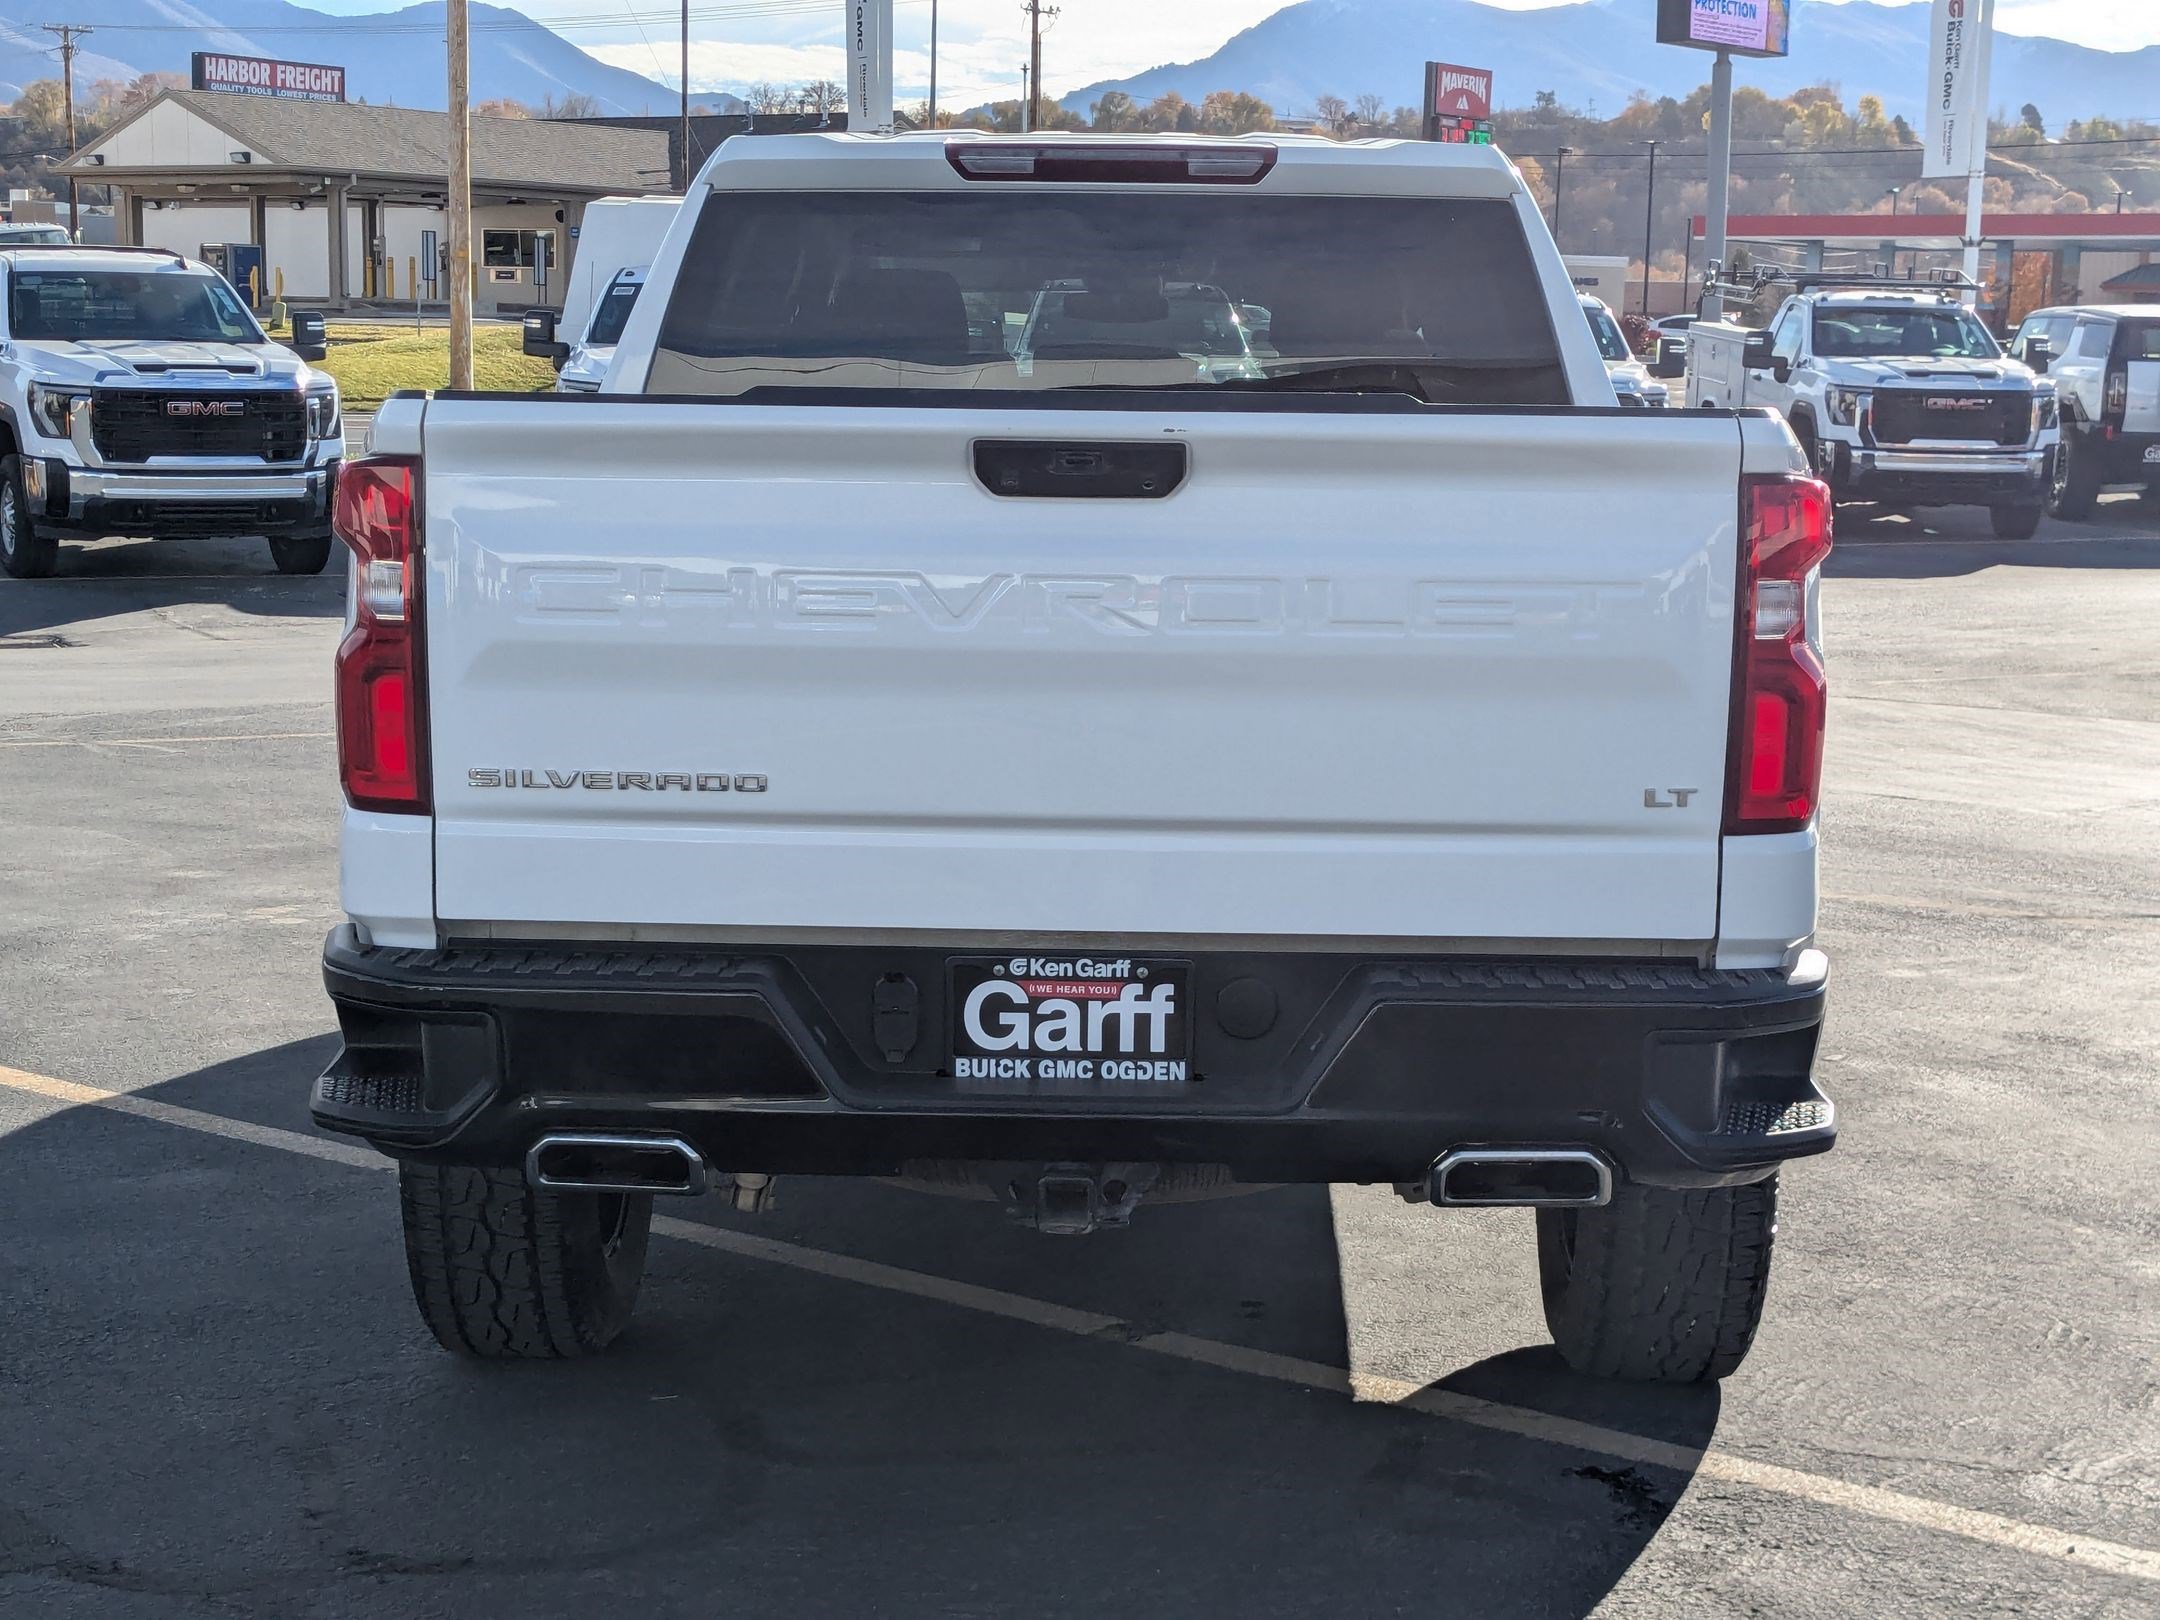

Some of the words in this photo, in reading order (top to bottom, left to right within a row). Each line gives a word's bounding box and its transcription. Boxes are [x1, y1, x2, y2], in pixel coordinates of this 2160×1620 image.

[1694, 0, 1757, 19] PROTECTION
[1955, 20, 1963, 42] Ken
[1945, 21, 1956, 65] Buick
[204, 56, 271, 86] HARBOR
[276, 64, 342, 93] FREIGHT
[210, 82, 246, 94] QUALITY
[247, 86, 272, 96] TOOLS
[276, 89, 308, 100] LOWEST
[308, 92, 337, 102] PRICES
[1441, 71, 1488, 104] MAVERIK
[1943, 72, 1954, 110] GMC
[167, 401, 244, 416] GMC
[515, 565, 1647, 639] CHEVROLET
[467, 767, 769, 793] SILVERADO
[1644, 788, 1699, 807] LT
[1030, 958, 1073, 977] Ken
[1075, 958, 1132, 978] Garff
[1036, 984, 1053, 994] WE
[1056, 985, 1086, 995] HEAR
[1088, 985, 1112, 995] YOU
[963, 979, 1175, 1053] Garff
[955, 1058, 1031, 1079] BUICK
[1038, 1059, 1094, 1080] GMC
[1100, 1060, 1186, 1081] OGDEN
